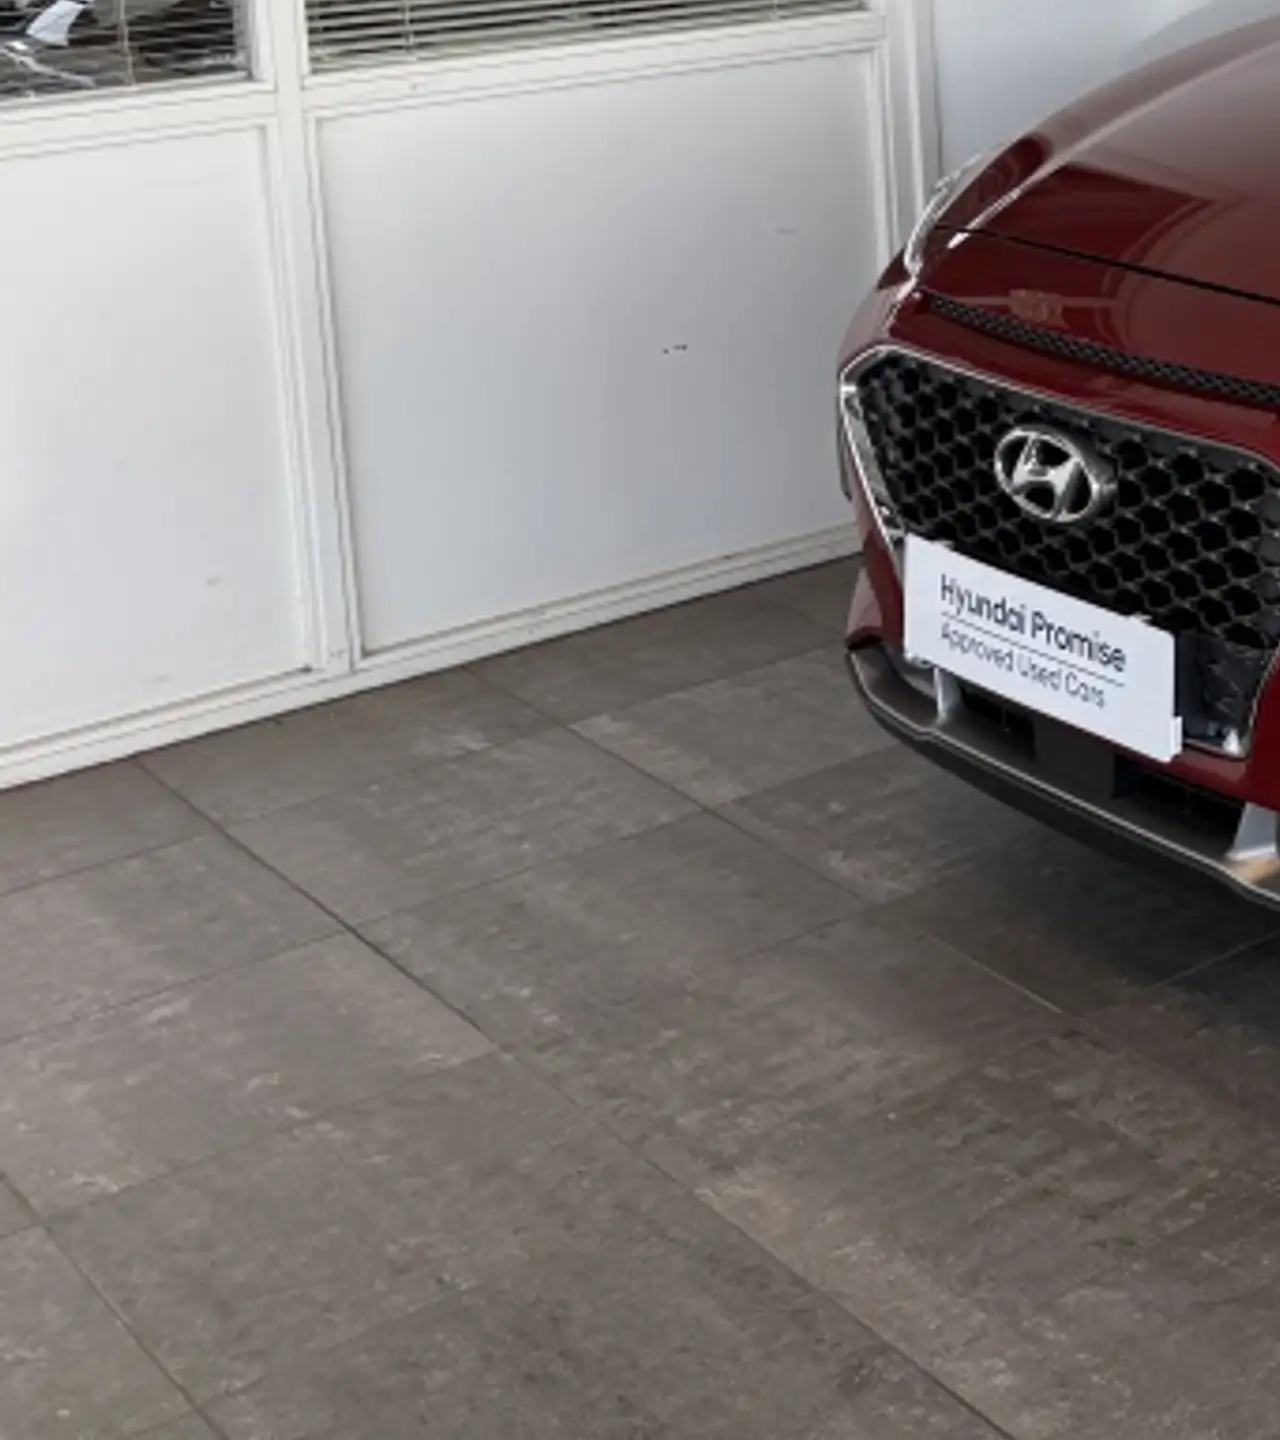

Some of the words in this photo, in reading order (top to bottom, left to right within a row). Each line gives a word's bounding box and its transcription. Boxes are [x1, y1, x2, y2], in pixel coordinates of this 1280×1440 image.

[940, 573, 1026, 635] Hyundai
[1030, 611, 1127, 672] Promise
[940, 621, 1014, 674] Approved
[1016, 651, 1062, 691] Used
[1064, 669, 1107, 709] Cars
